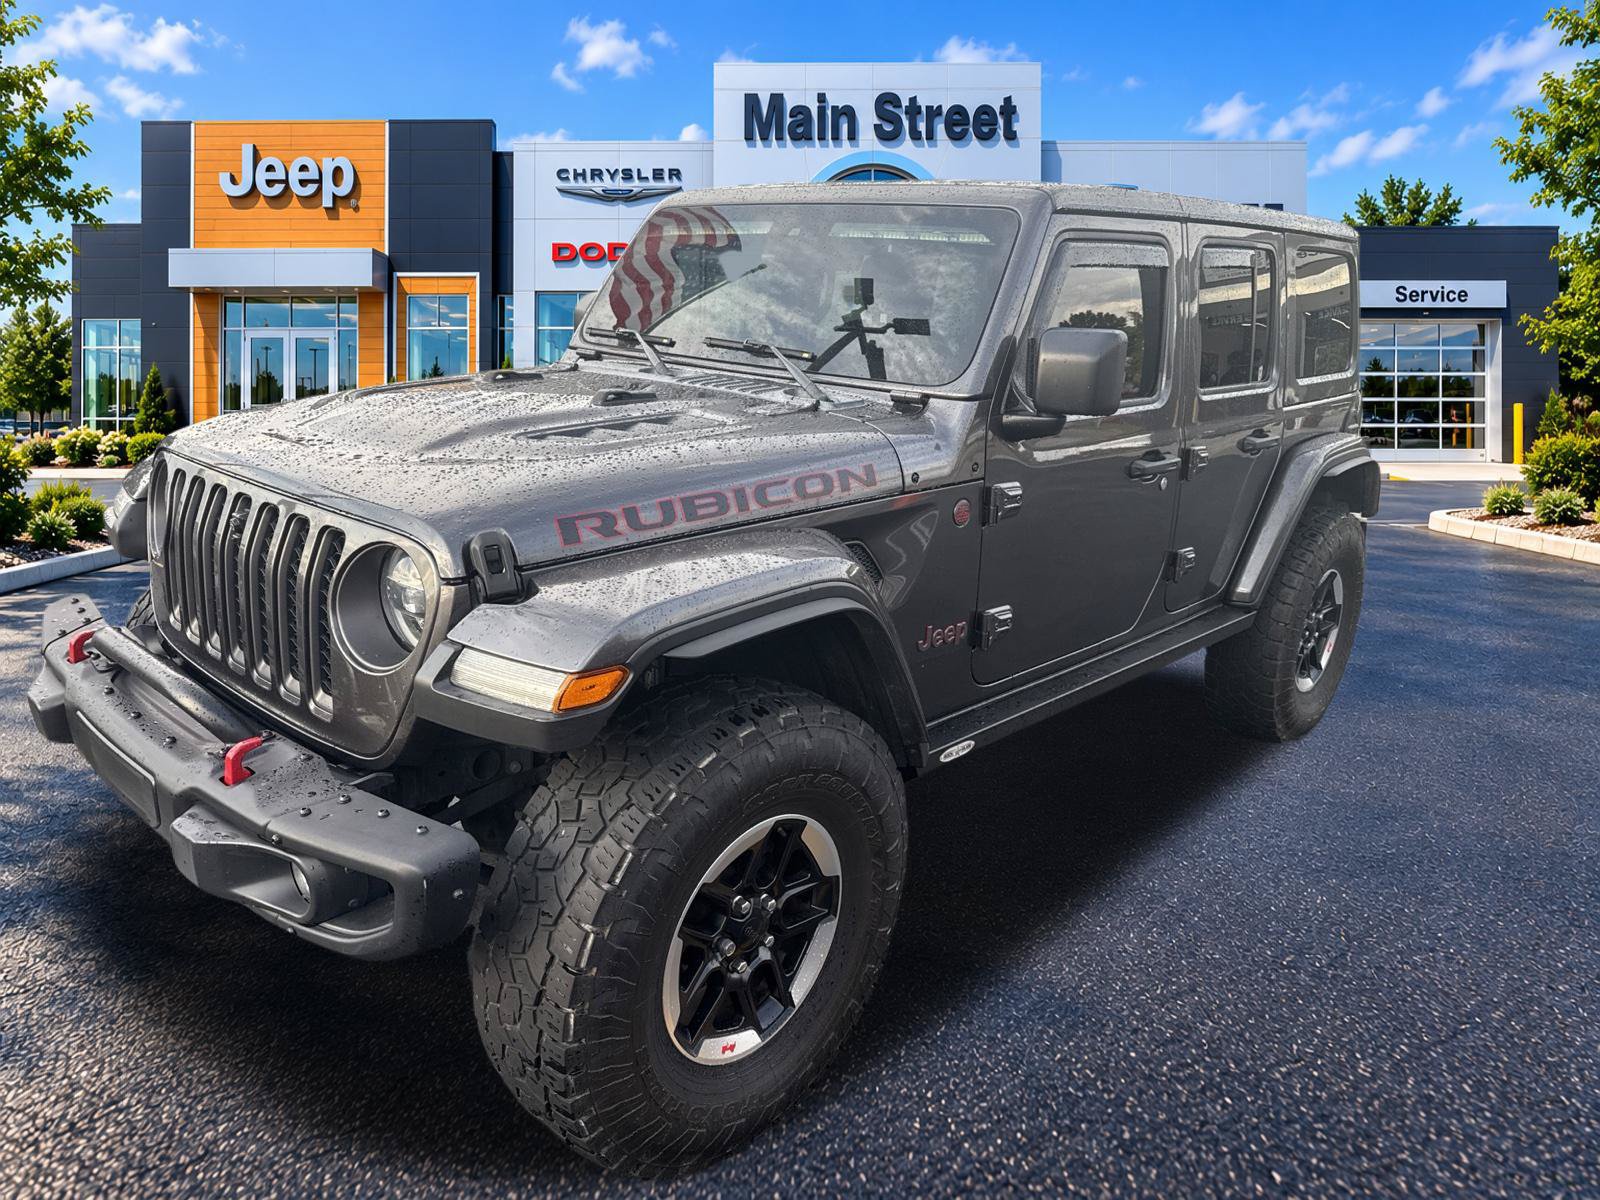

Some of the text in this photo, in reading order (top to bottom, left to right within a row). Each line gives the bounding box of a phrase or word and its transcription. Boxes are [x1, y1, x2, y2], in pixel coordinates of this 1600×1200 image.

[743, 91, 1017, 141] Main Street
[218, 143, 355, 208] Jeep
[556, 168, 683, 182] CHRYSLER
[1395, 285, 1469, 303] Service
[553, 461, 881, 548] RUBICON
[917, 620, 968, 652] Jeep
